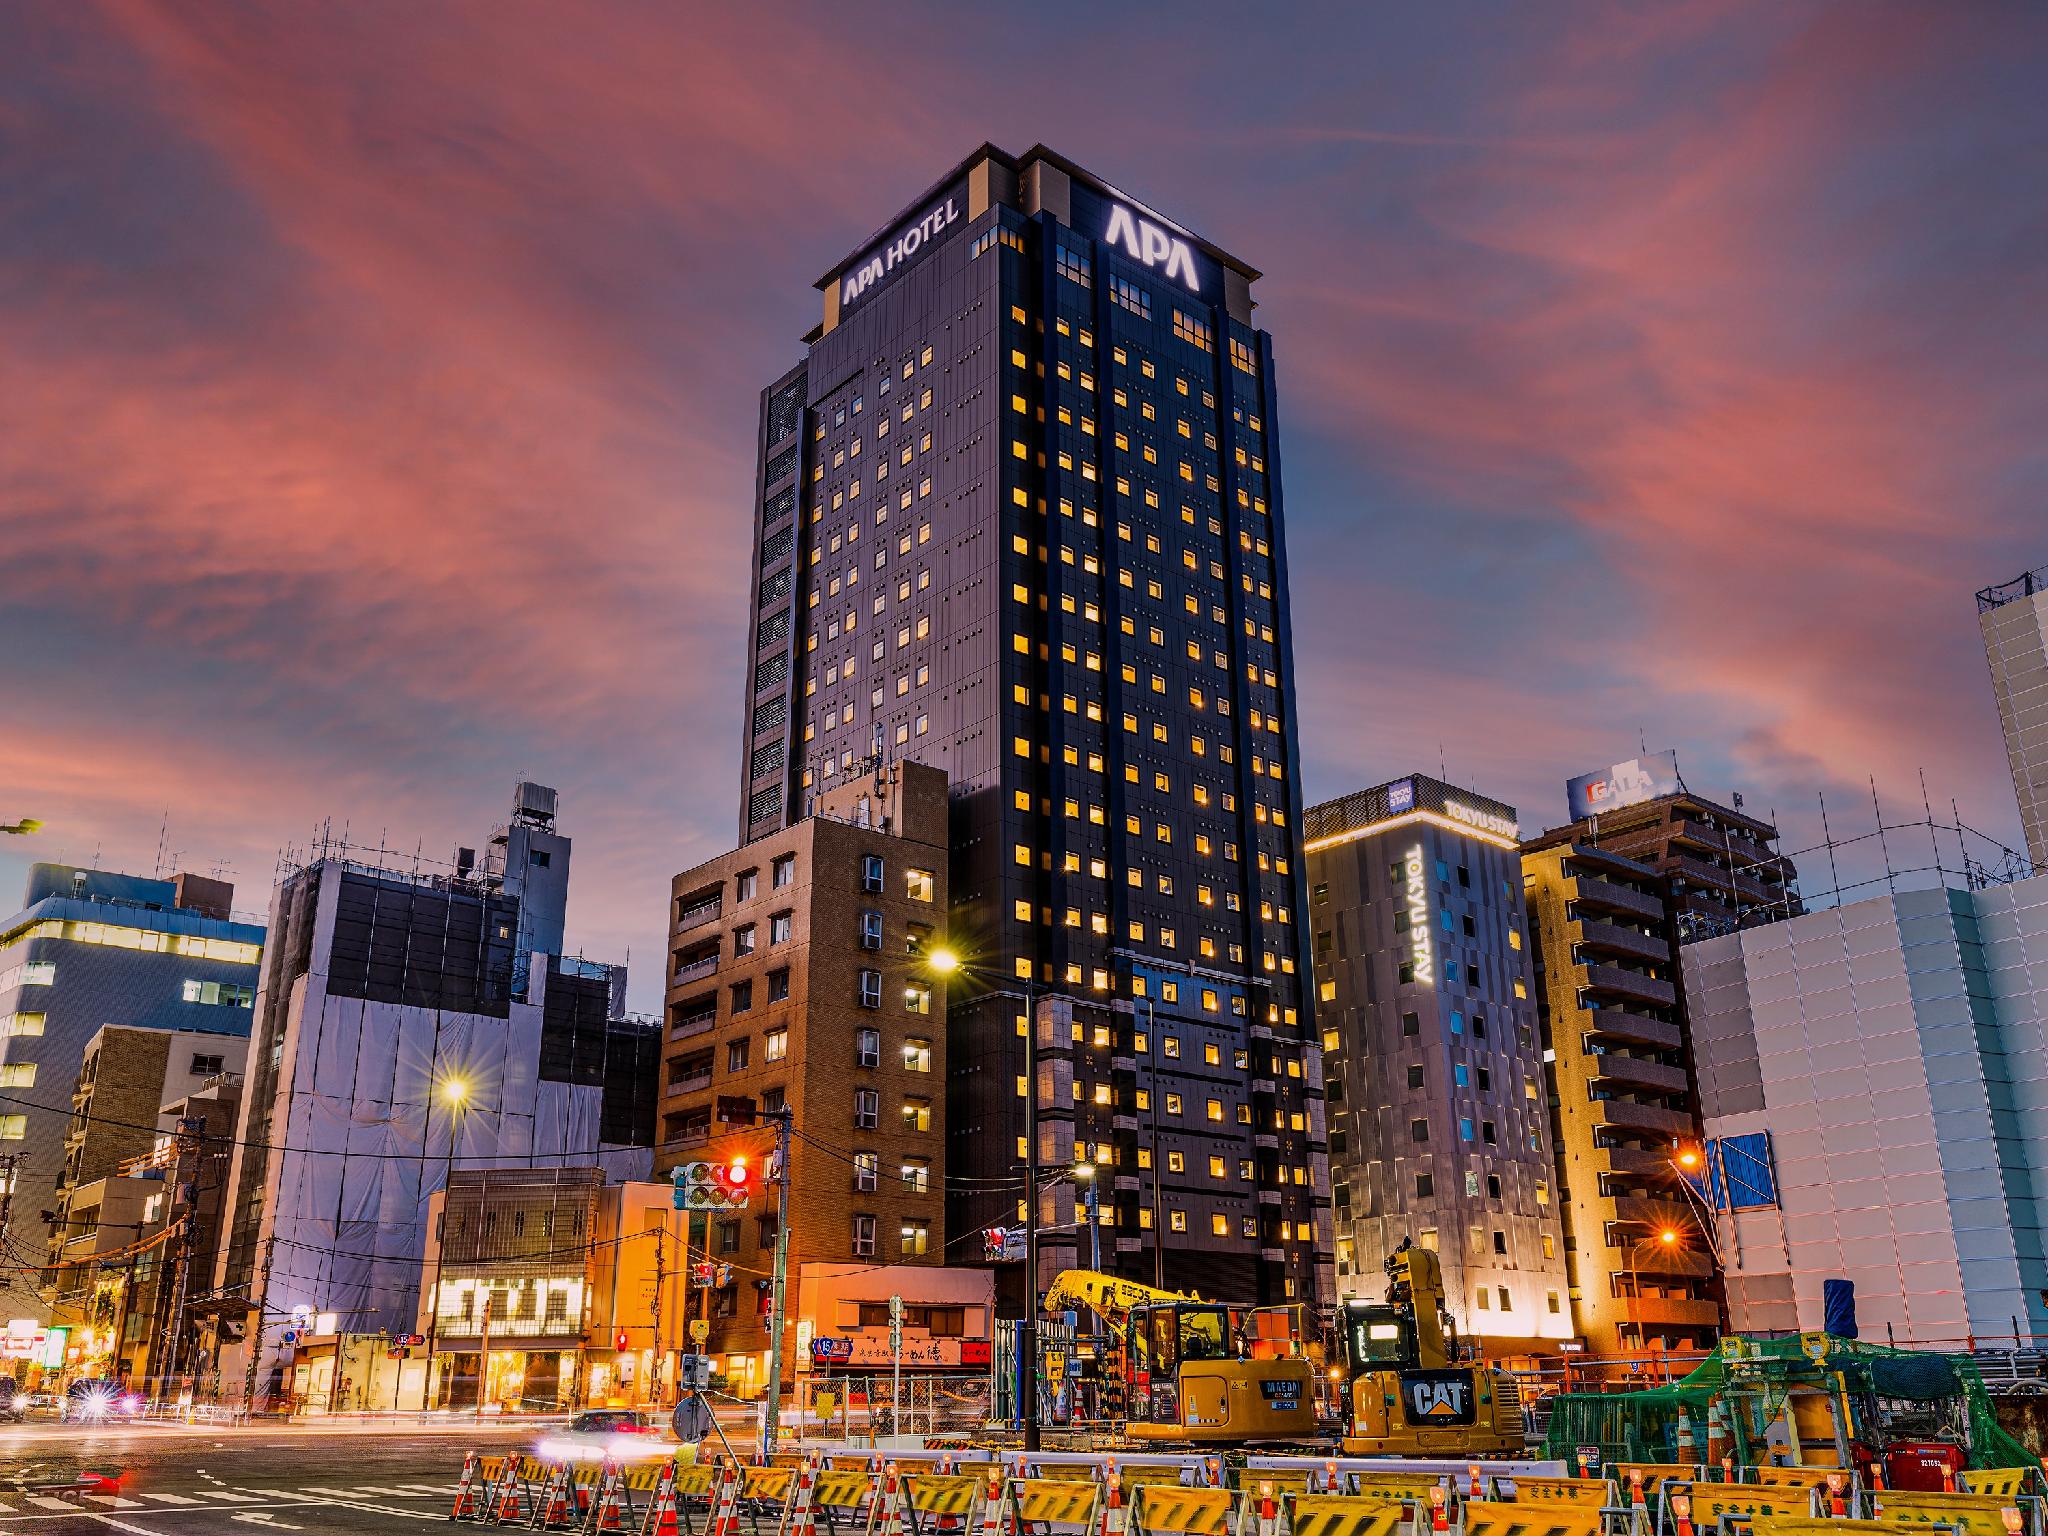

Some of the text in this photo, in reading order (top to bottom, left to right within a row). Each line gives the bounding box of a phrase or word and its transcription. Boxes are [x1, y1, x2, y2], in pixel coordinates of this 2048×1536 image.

[842, 198, 961, 306] APA HOTEL
[1104, 203, 1201, 292] APA
[1390, 793, 1412, 807] STAY
[1445, 799, 1518, 838] TOKYU STAY
[1406, 844, 1433, 983] TOKYU STAY
[821, 1340, 831, 1352] 15
[1413, 1382, 1464, 1416] CAT
